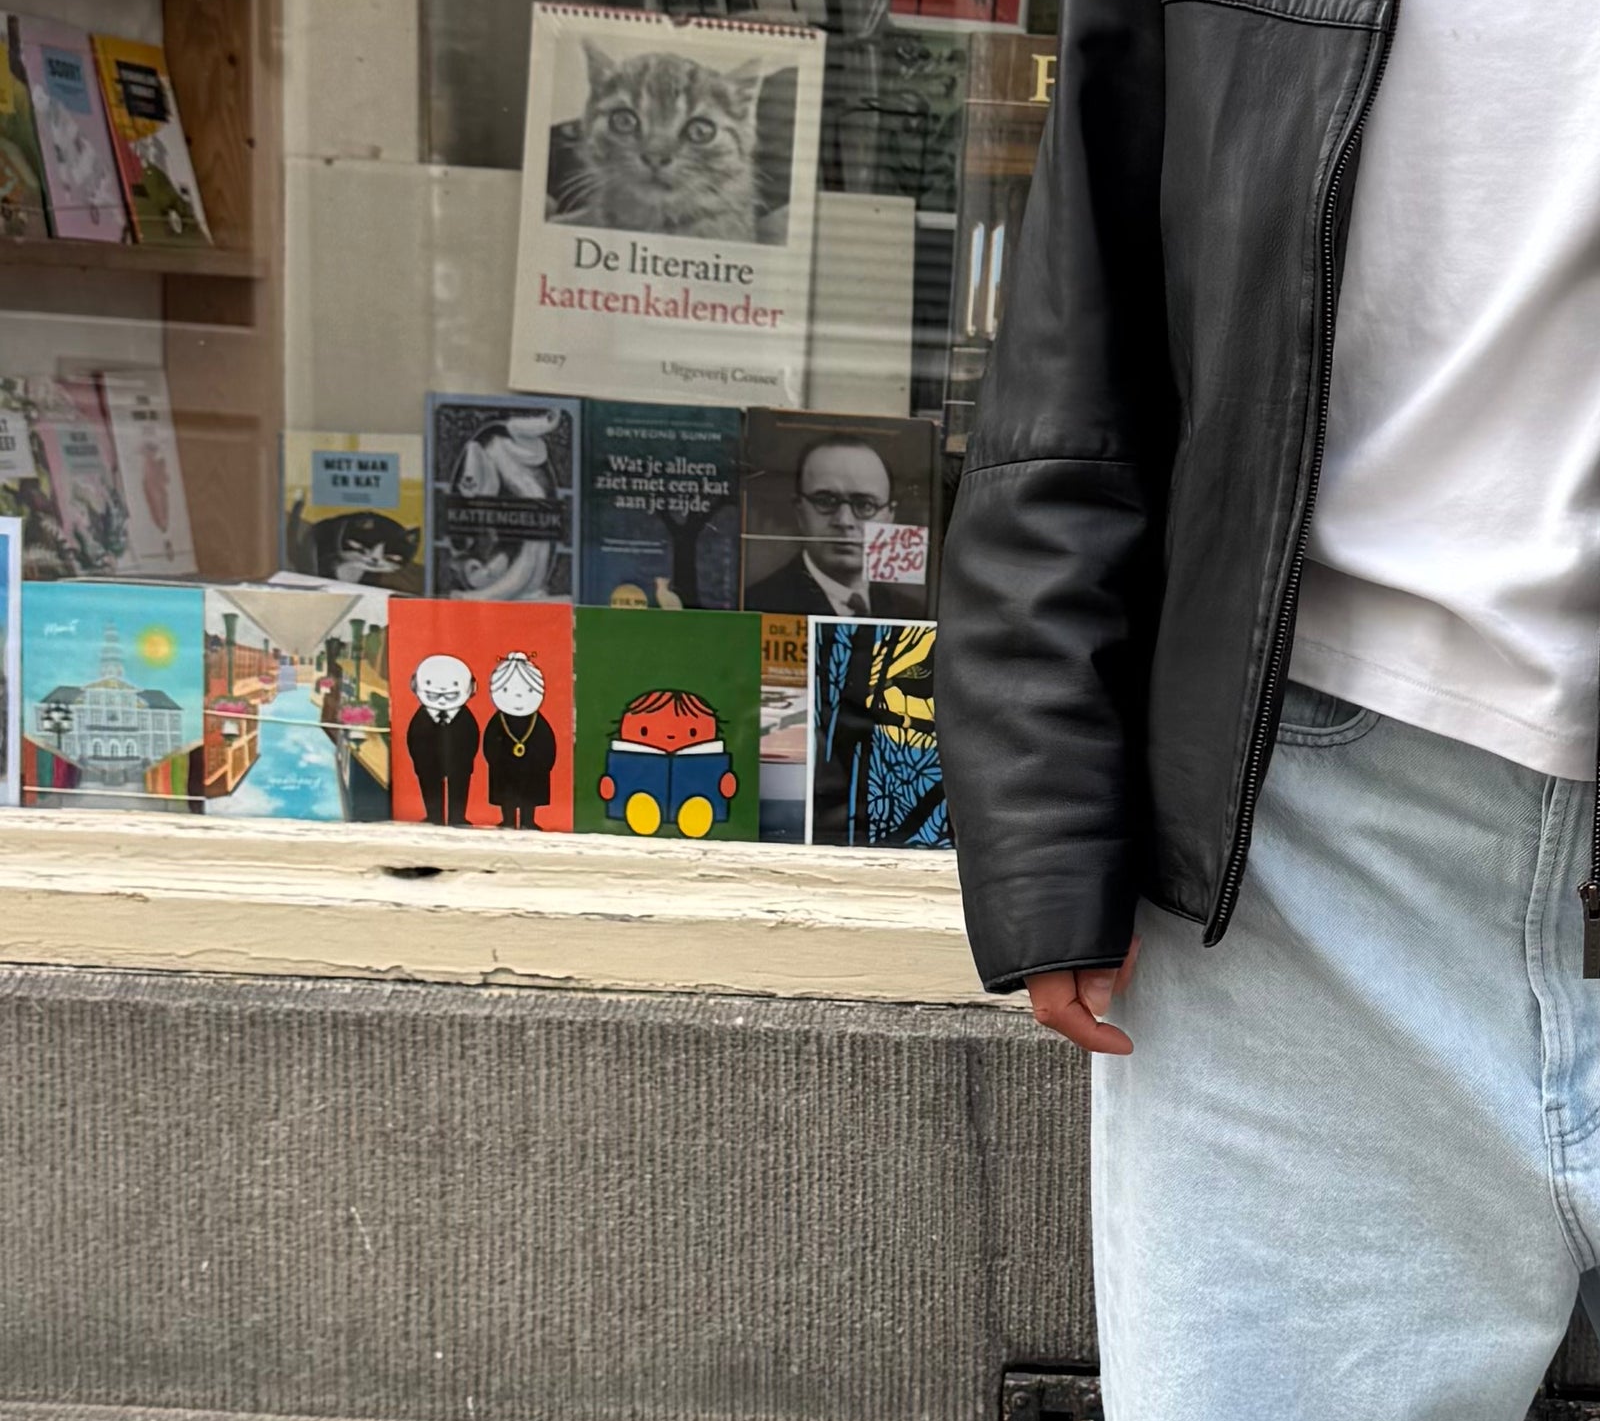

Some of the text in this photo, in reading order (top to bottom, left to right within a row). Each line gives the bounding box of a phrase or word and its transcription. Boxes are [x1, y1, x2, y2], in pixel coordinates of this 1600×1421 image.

[573, 237, 754, 286] De literaire
[538, 273, 785, 329] kattenkalender
[608, 455, 718, 478] Wat je alleen
[632, 477, 665, 492] met
[668, 480, 700, 493] een
[702, 476, 731, 496] kat
[614, 494, 711, 517] aan je zijde
[447, 507, 562, 529] KATTENGELUK
